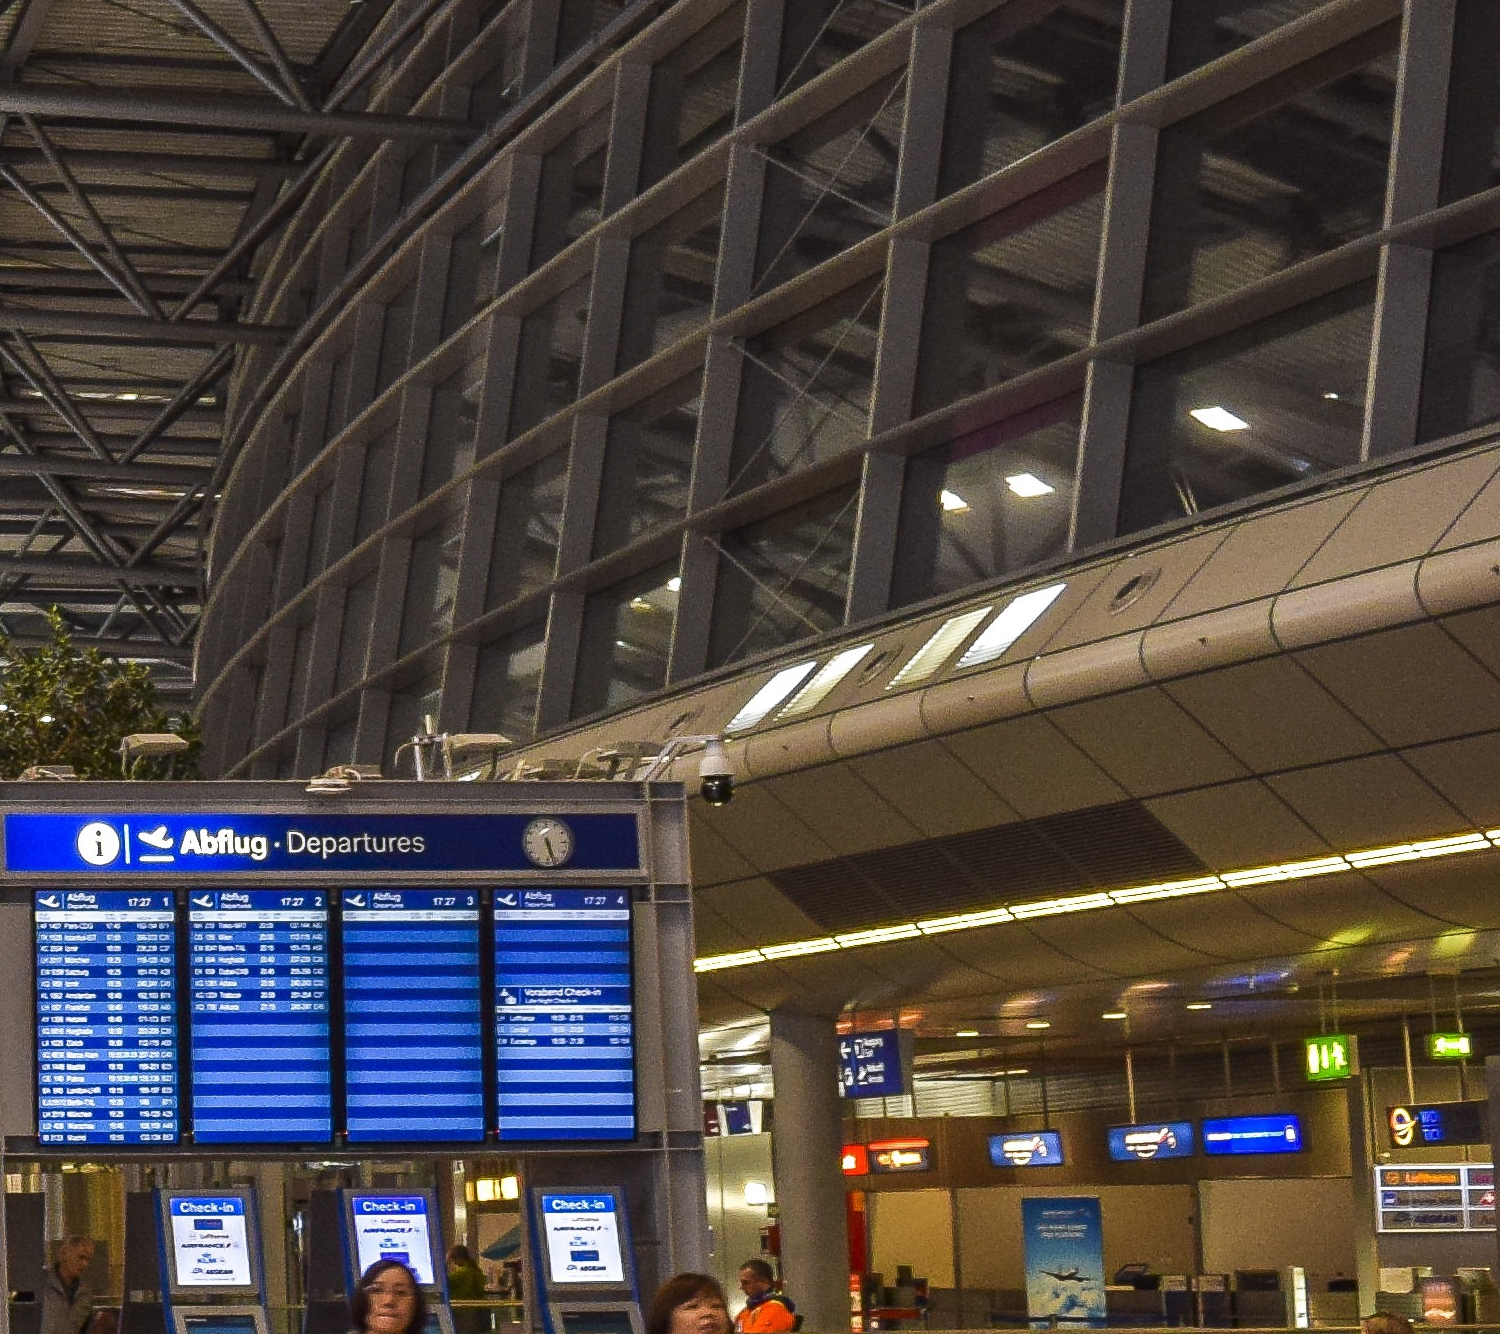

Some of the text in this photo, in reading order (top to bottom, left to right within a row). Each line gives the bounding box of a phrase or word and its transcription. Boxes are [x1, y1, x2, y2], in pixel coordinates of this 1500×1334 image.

[180, 828, 425, 861] Abflug Departures
[163, 897, 169, 906] 1
[315, 897, 322, 906] 2
[467, 896, 474, 906] 3
[617, 896, 624, 905] 4
[180, 1202, 234, 1213] Check-in
[363, 1201, 416, 1212] Check-in
[552, 1199, 605, 1210] Check-in
